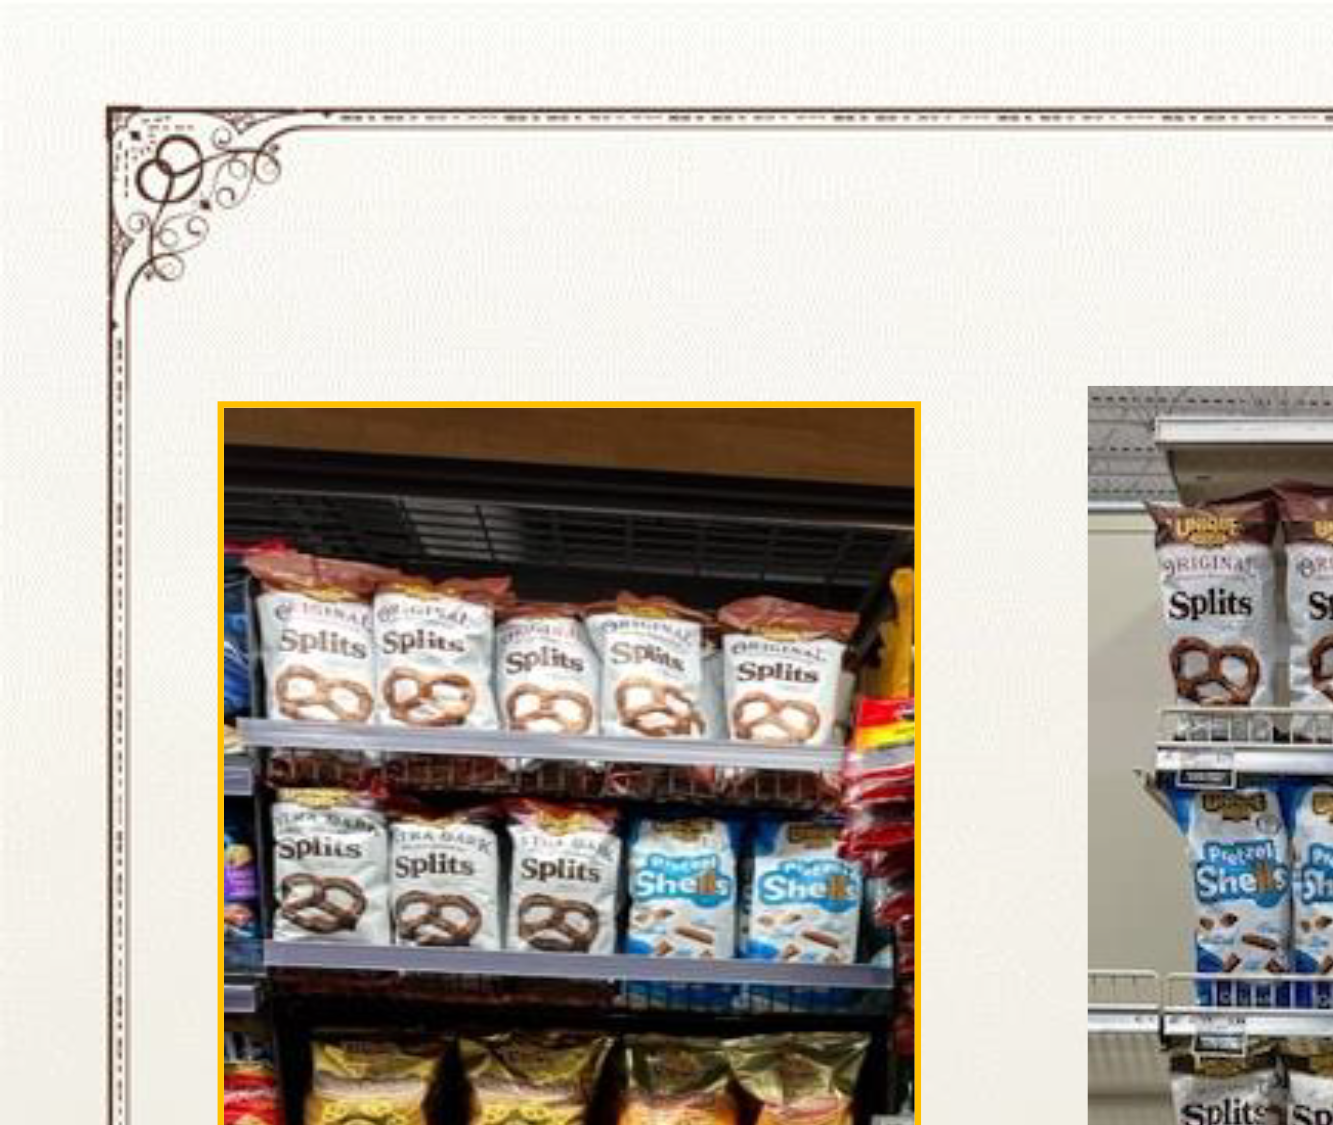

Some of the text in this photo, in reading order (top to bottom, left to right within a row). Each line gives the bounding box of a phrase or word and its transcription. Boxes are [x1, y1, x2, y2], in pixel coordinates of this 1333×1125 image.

[1168, 588, 1253, 621] Splits
[279, 629, 367, 659] Splits
[382, 628, 465, 656] Splits
[506, 646, 583, 675] Splits
[611, 641, 685, 672] Splits
[737, 659, 819, 684] Splits
[278, 836, 363, 861] Splits
[1210, 845, 1274, 866] Pretzel
[396, 852, 475, 879] Splits
[521, 857, 600, 883] Splits
